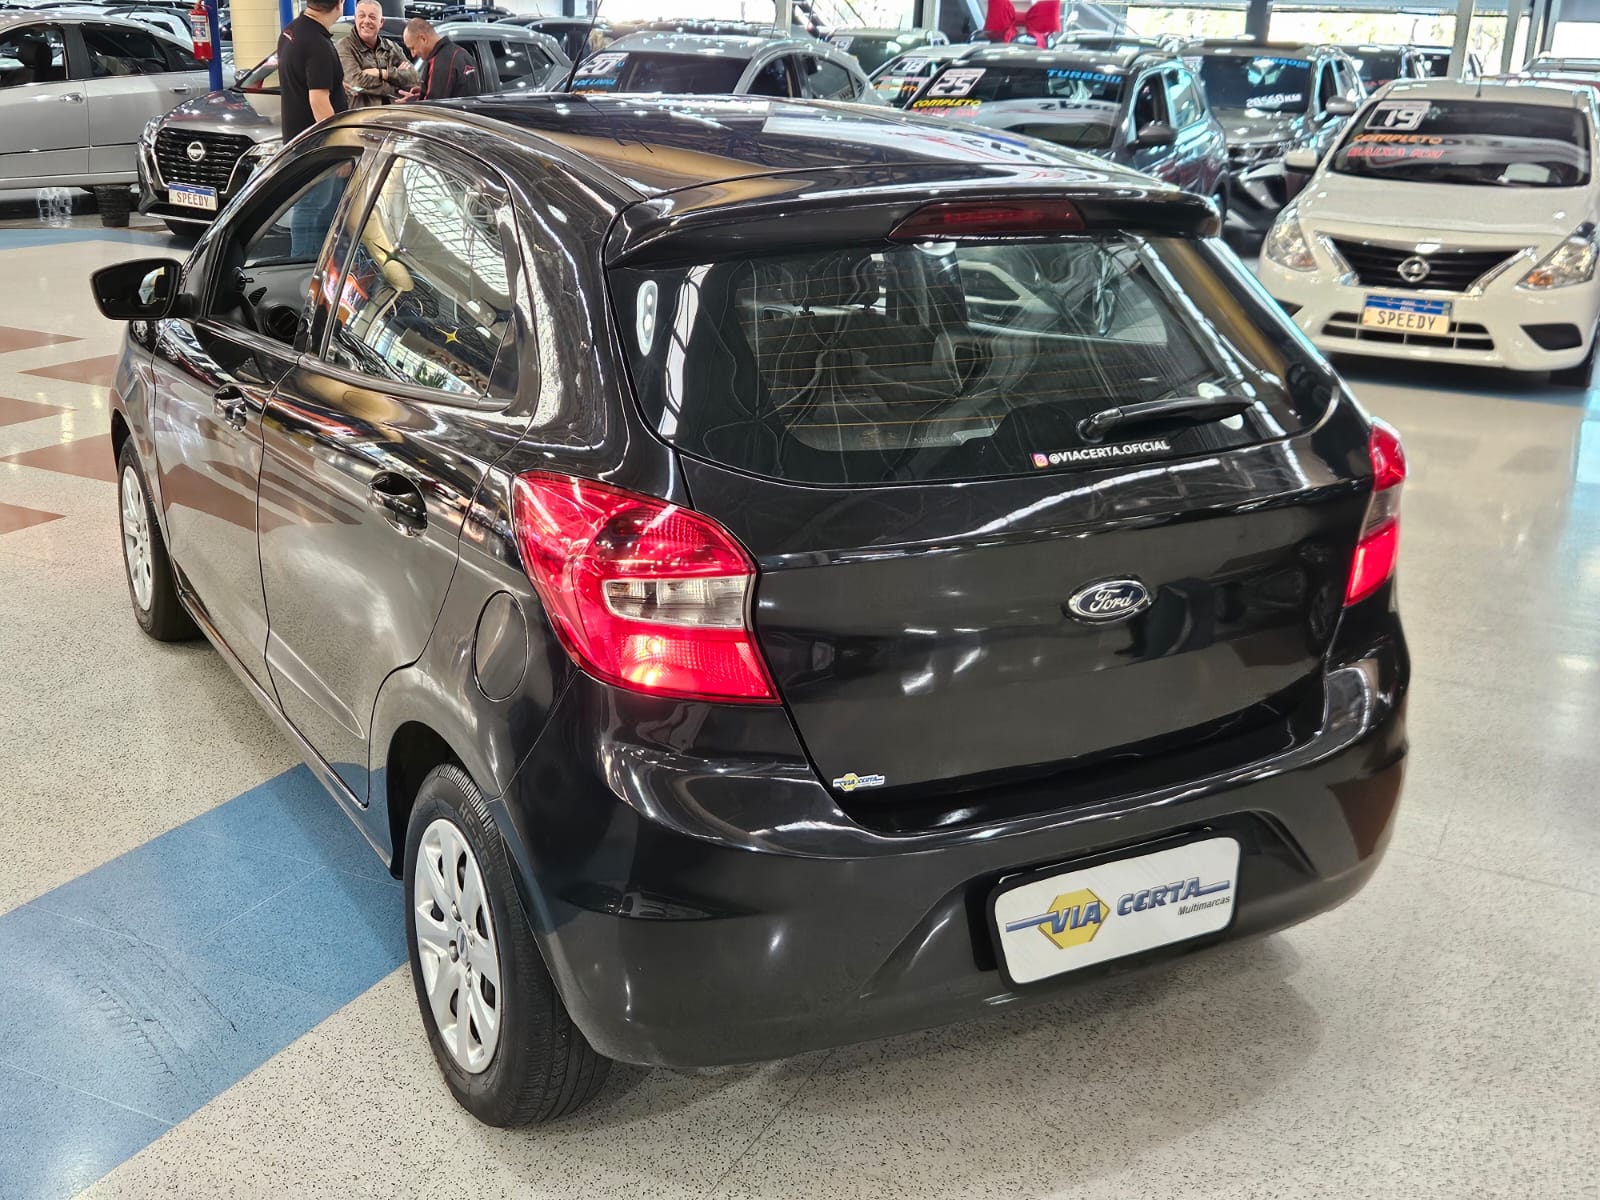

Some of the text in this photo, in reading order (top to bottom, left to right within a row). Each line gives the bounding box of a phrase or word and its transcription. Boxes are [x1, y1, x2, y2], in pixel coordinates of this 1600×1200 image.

[935, 77, 973, 95] 25
[912, 98, 982, 108] COMPLETO
[1384, 109, 1419, 128] 19
[1353, 133, 1443, 145] COMPLETO
[176, 192, 209, 207] SPEEDY
[1377, 310, 1436, 331] SPEEDY
[1048, 440, 1171, 465] @VIACERTA.OFICIAL
[1089, 588, 1134, 612] Ford
[1051, 877, 1200, 934] VIA CERTA
[1177, 896, 1231, 916] Multimarcas
